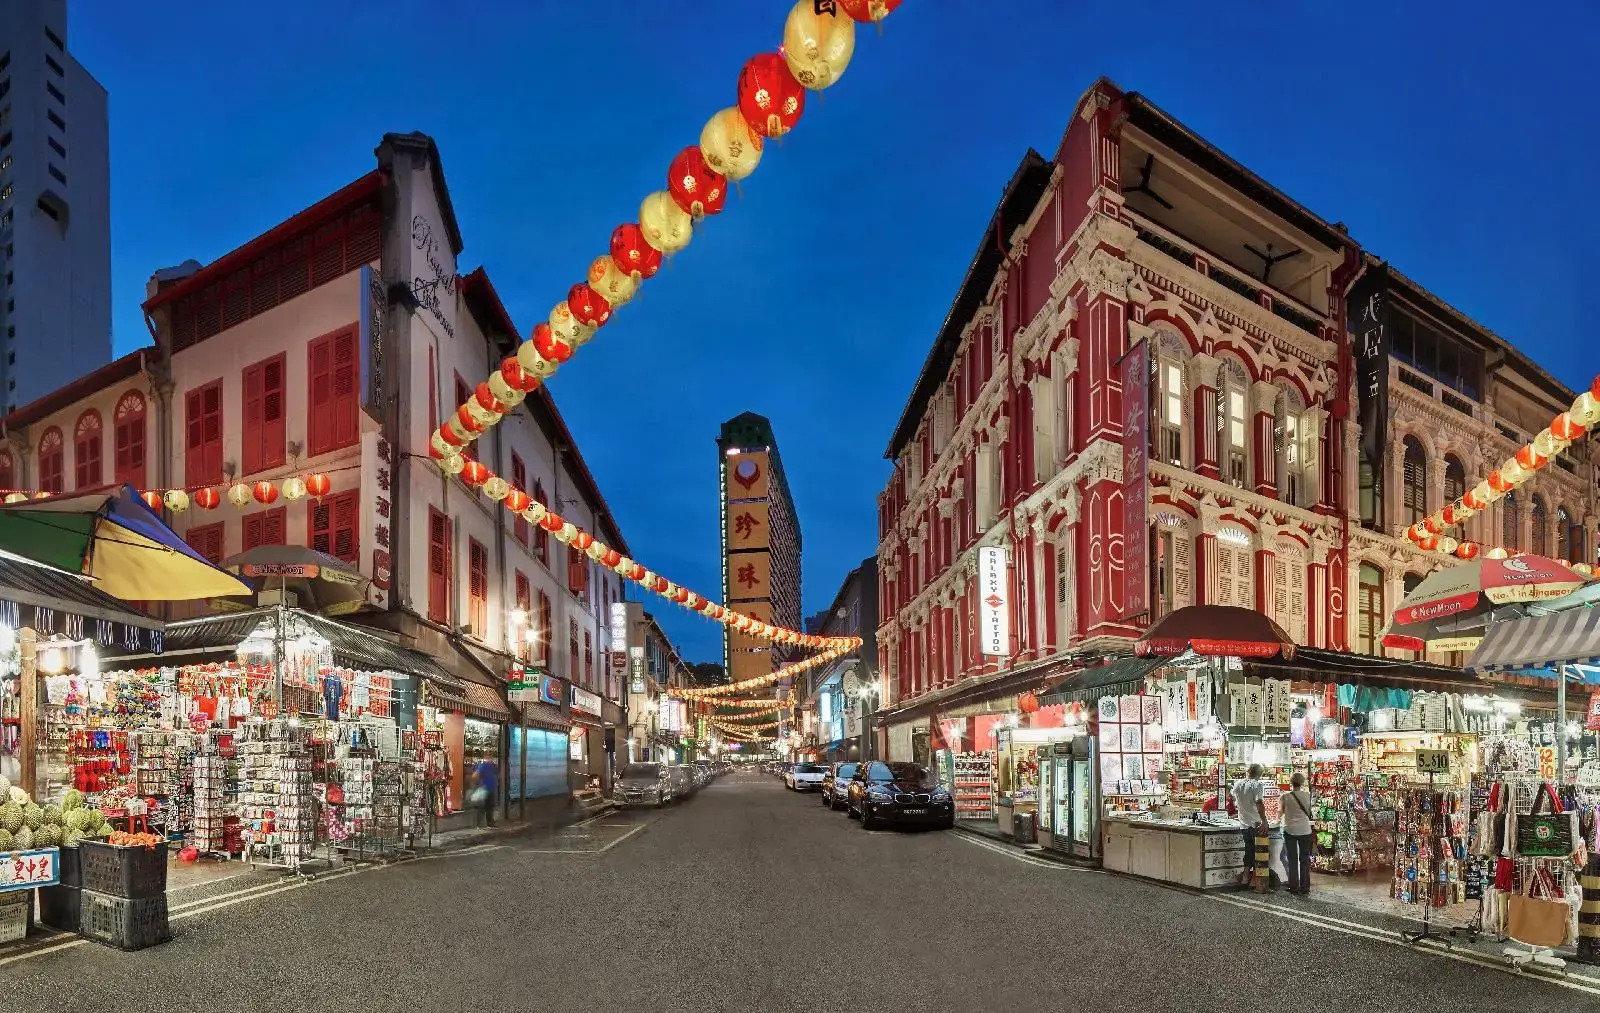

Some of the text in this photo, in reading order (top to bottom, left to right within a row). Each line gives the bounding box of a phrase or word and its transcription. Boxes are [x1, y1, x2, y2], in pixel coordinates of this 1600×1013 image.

[989, 550, 998, 593] GALAXY
[1518, 590, 1527, 598] in
[1418, 601, 1461, 617] NewMoon
[991, 609, 1000, 652] TATTOO
[1418, 753, 1426, 768] 5
[1431, 754, 1448, 768] $10
